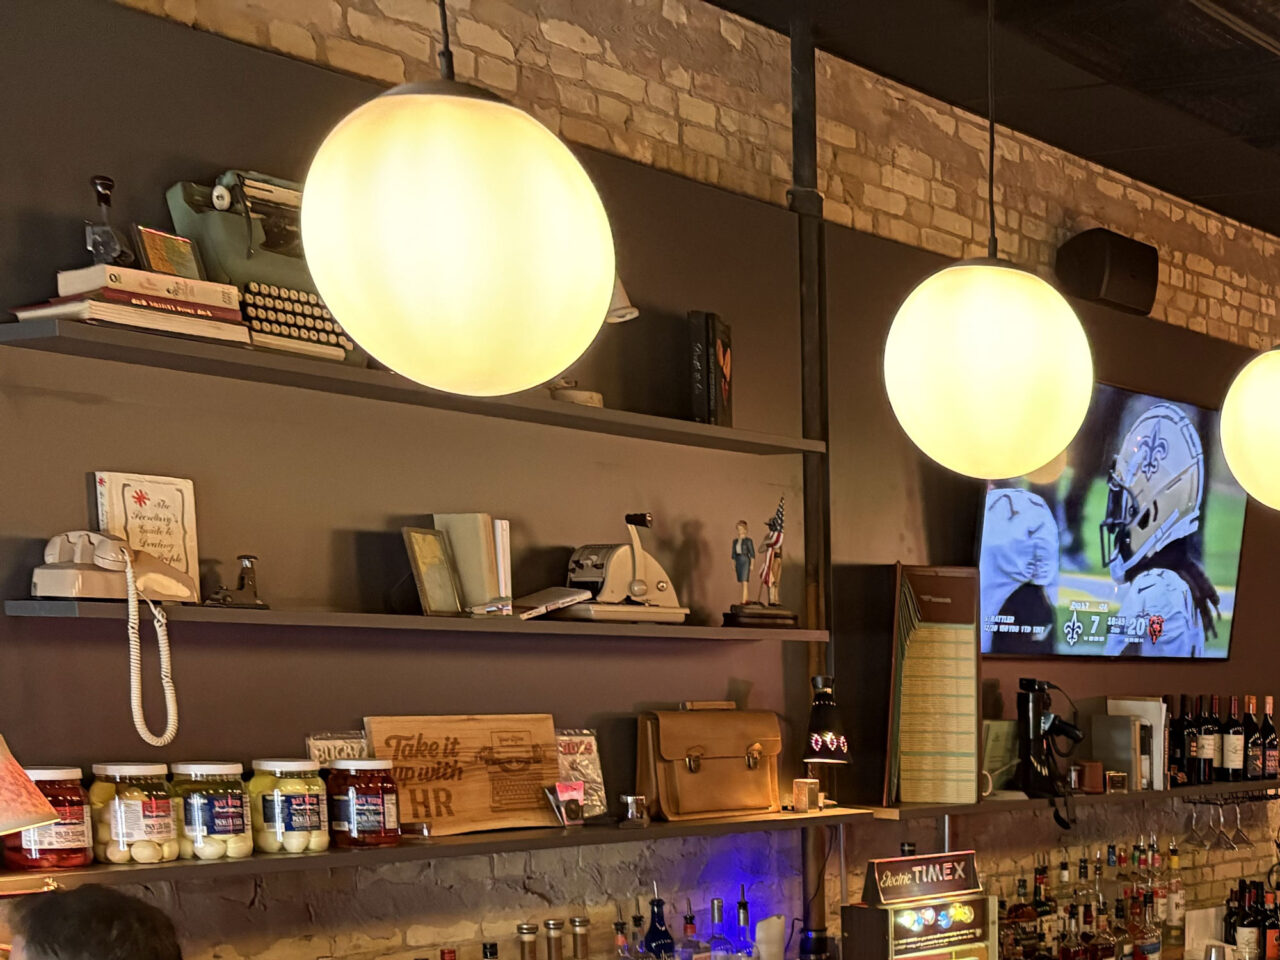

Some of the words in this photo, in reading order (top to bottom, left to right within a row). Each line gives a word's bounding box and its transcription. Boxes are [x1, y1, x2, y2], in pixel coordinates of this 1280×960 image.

[1091, 616, 1100, 634] 7
[1127, 617, 1145, 636] 20
[384, 733, 441, 760] Take
[444, 736, 461, 758] it
[416, 760, 464, 782] with
[408, 787, 455, 819] HR
[880, 870, 912, 888] Electric
[912, 861, 965, 884] TIMEX
